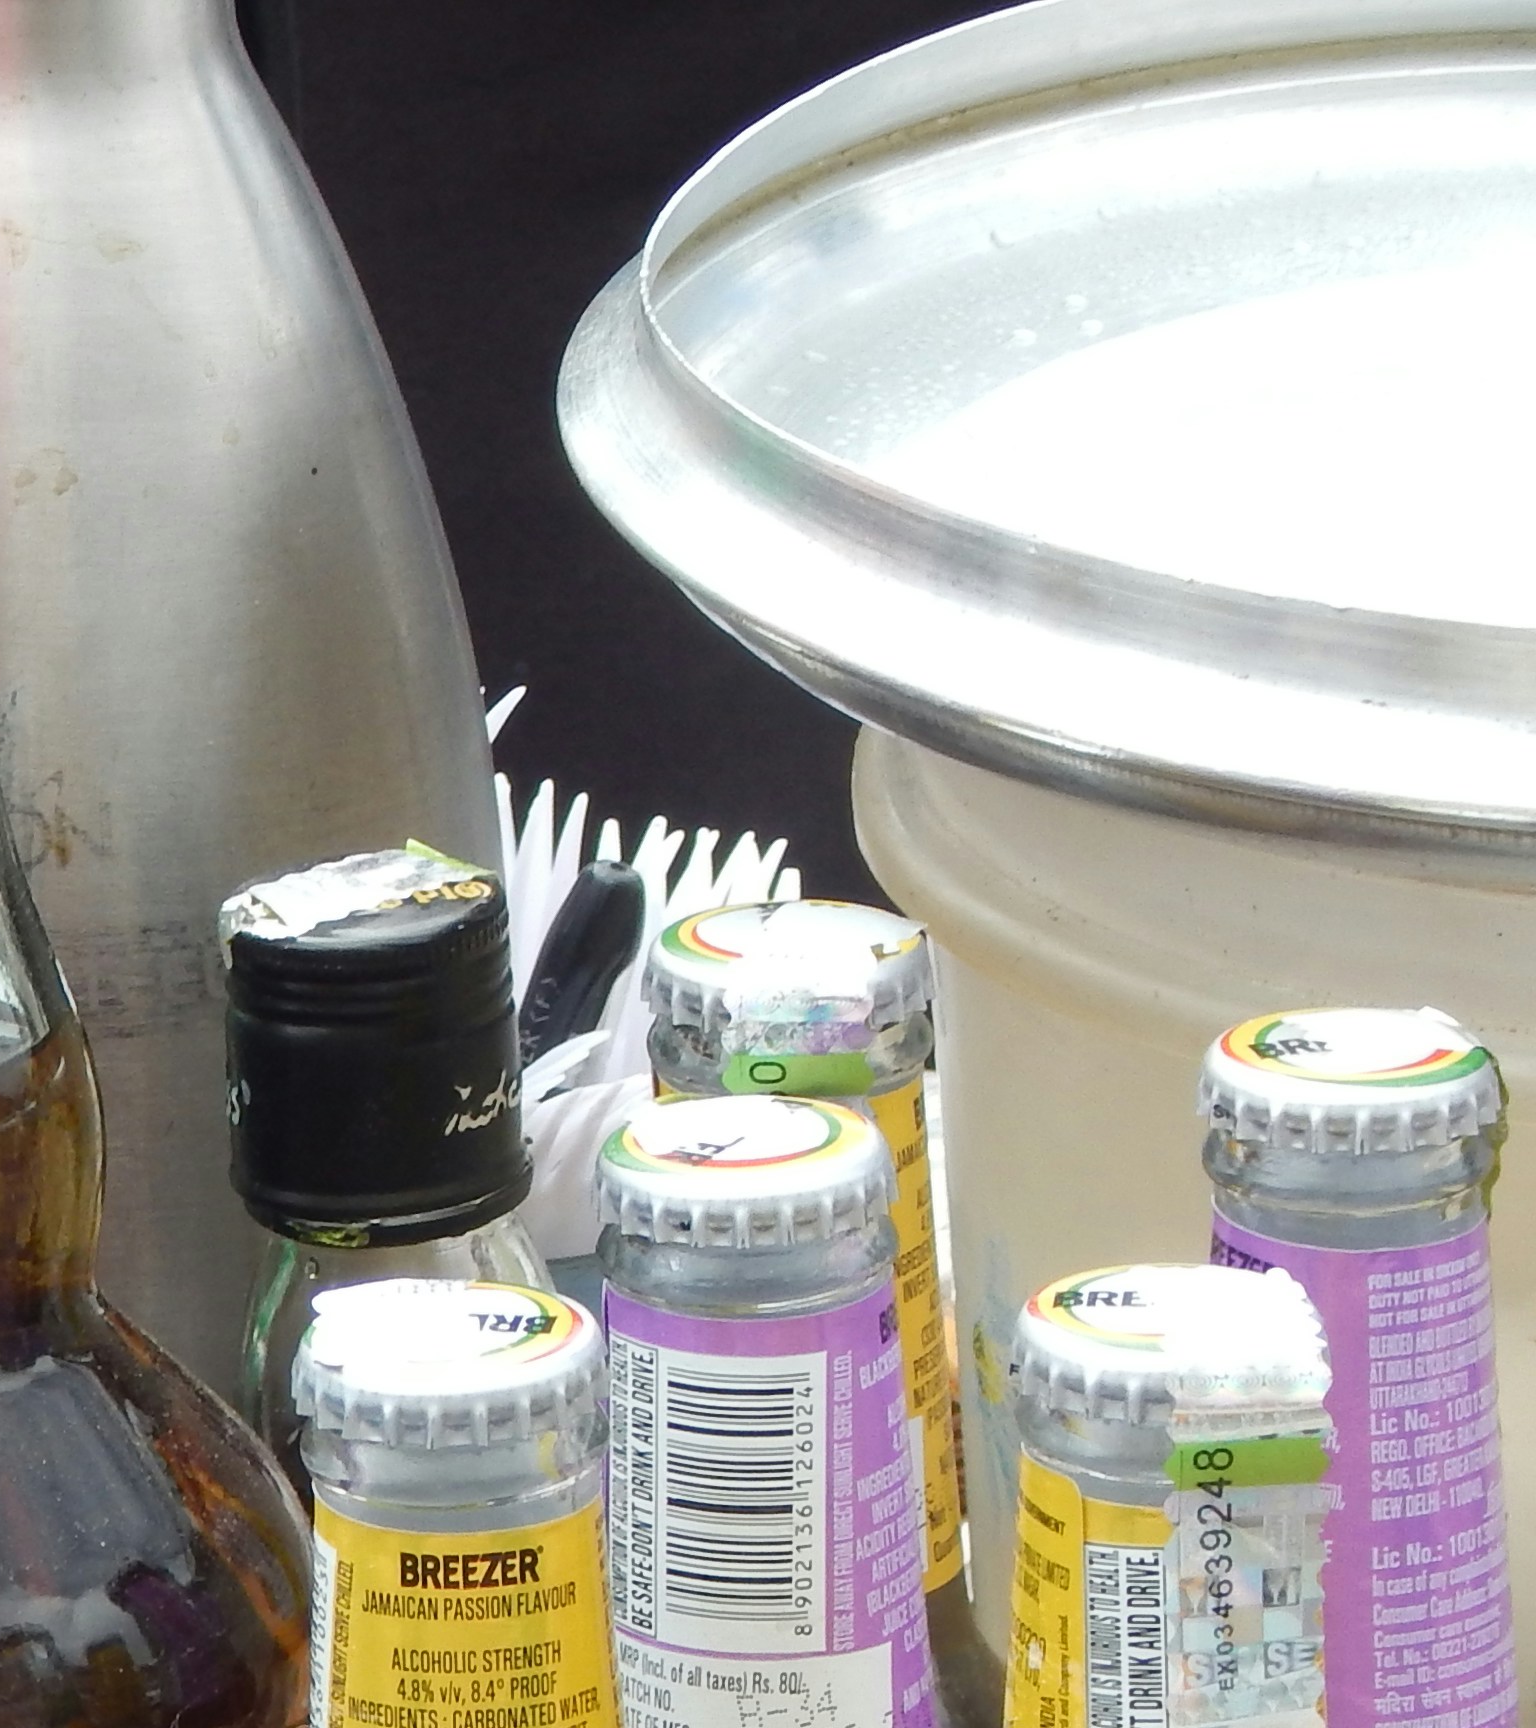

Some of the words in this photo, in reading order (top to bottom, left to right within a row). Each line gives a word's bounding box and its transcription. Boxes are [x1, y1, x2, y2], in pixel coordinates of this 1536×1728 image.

[632, 1409, 653, 1444] AND
[632, 1447, 653, 1501] DRINK
[399, 1548, 541, 1590] BREEZER
[362, 1589, 439, 1621] JAMAICAN
[443, 1591, 513, 1621] PASSION
[517, 1582, 577, 1617] FLAVOUR
[632, 1605, 654, 1631] BE
[391, 1645, 475, 1675] ALCOHOLIC
[481, 1640, 562, 1672] STRENGTH
[396, 1678, 434, 1702] 4.8%
[440, 1678, 466, 1705] v/v,
[511, 1671, 559, 1699] PROOF
[671, 1660, 684, 1684] of
[687, 1660, 702, 1686] all
[705, 1666, 748, 1694] taxes)
[752, 1670, 774, 1695] Rs.
